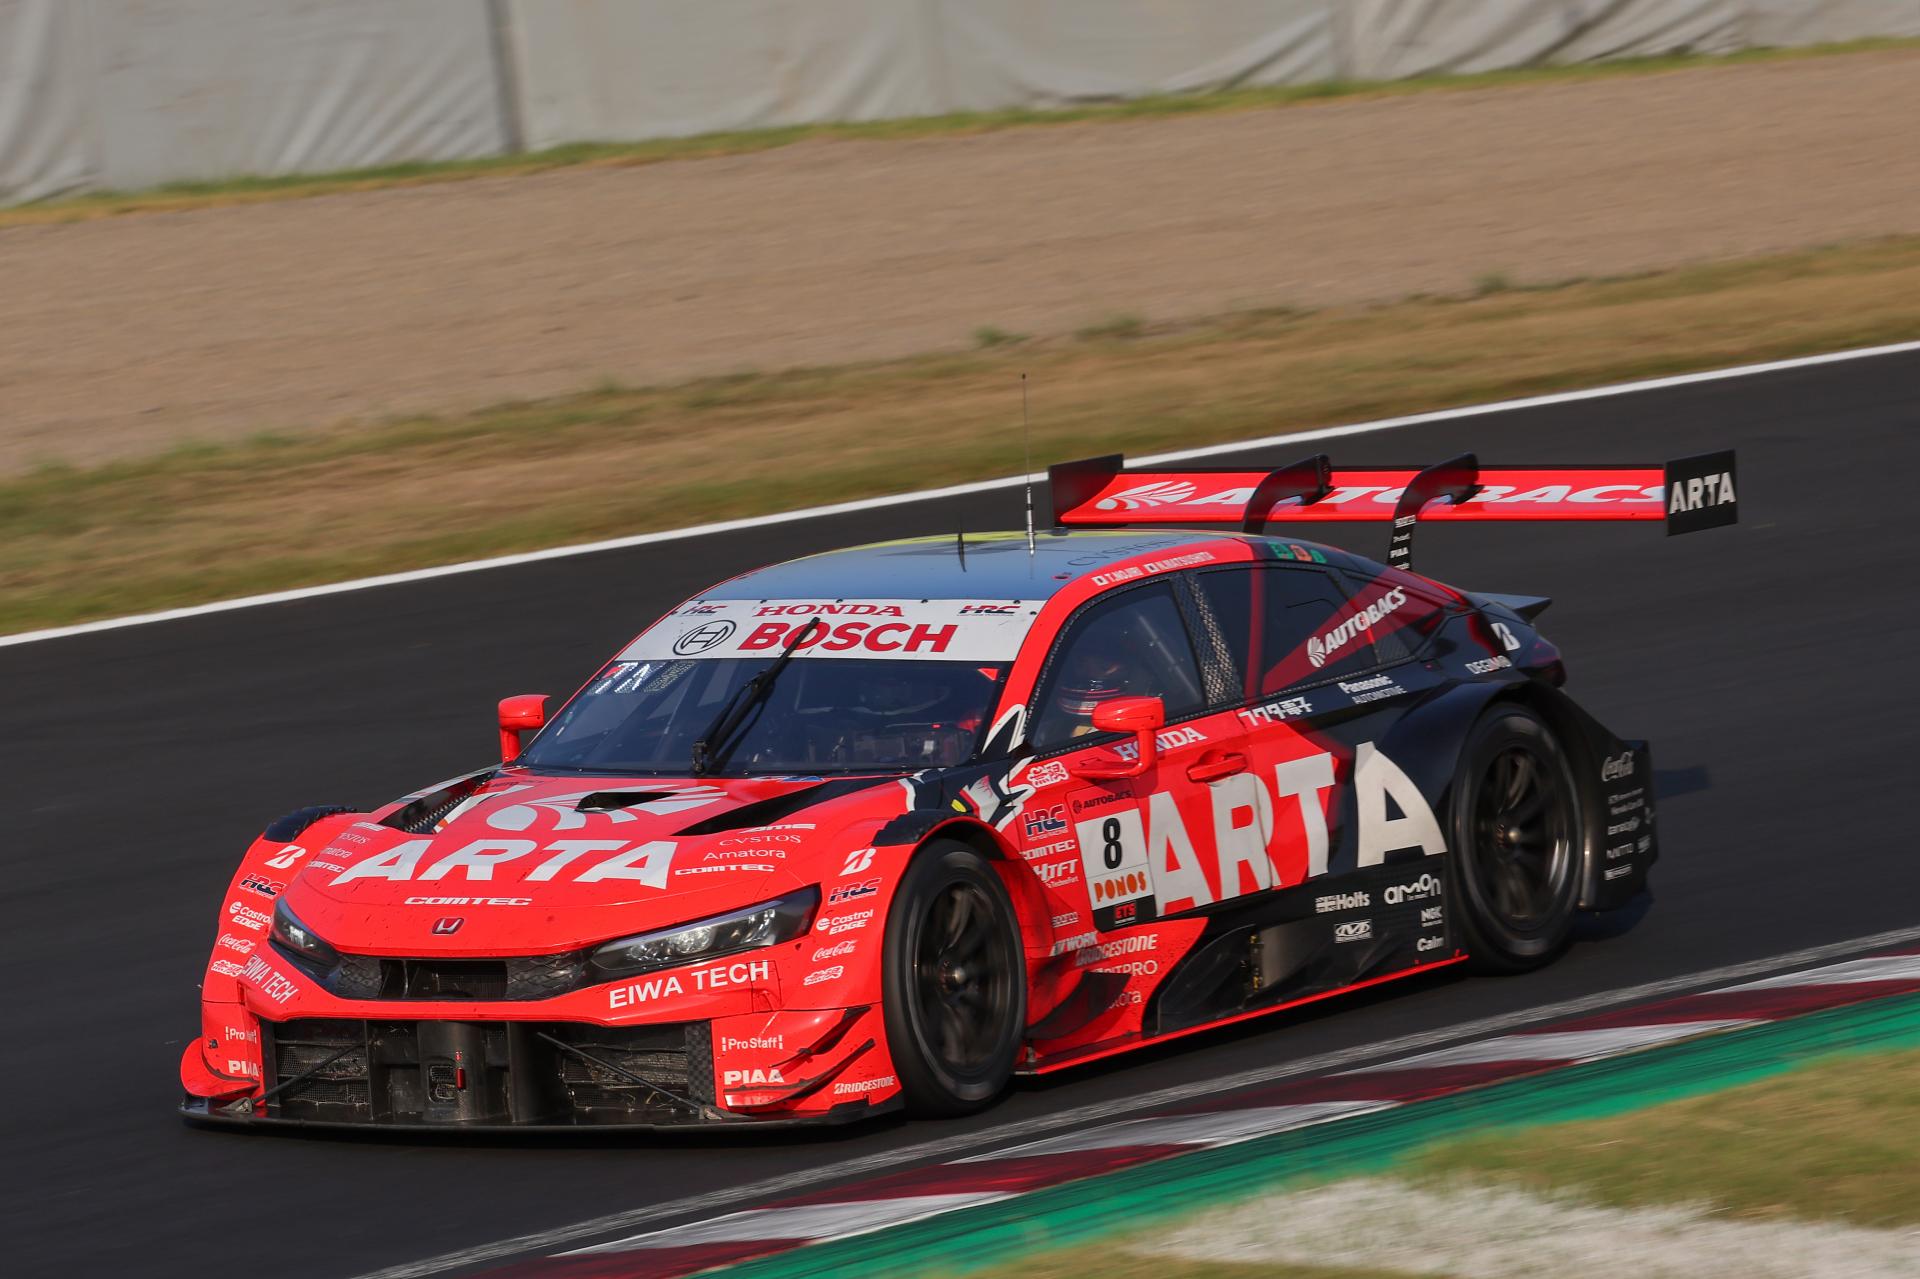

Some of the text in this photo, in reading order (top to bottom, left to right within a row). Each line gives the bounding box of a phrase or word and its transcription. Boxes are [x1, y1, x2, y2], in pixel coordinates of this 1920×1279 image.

[1668, 471, 1737, 514] ARTA
[751, 604, 905, 618] HONDA
[959, 605, 1021, 614] HRC
[1325, 585, 1407, 655] AUTOBACS
[736, 622, 958, 653] BOSCH
[1337, 674, 1394, 694] Panasonic
[1083, 791, 1133, 809] AUTOBACS
[1023, 804, 1066, 836] HRC
[1149, 741, 1448, 917] ARTA
[719, 835, 801, 846] CVSTOS
[1103, 817, 1122, 869] 8
[329, 839, 678, 889] ARTA
[703, 848, 786, 862] Amatora
[675, 864, 775, 875] COMTEC
[829, 878, 882, 902] HRC
[1094, 870, 1147, 902] PONOS
[1384, 873, 1441, 905] amon
[404, 897, 533, 906] COMTEC
[1336, 891, 1370, 910] Holts
[231, 914, 265, 931] EDGE
[829, 919, 867, 935] EDGE
[831, 909, 873, 926] Castrol
[265, 971, 299, 1004] TECH
[610, 975, 684, 1008] EIWA
[691, 960, 769, 990] TECH
[724, 1069, 784, 1085] PIAA
[834, 1076, 897, 1094] BRIDGESTONE
